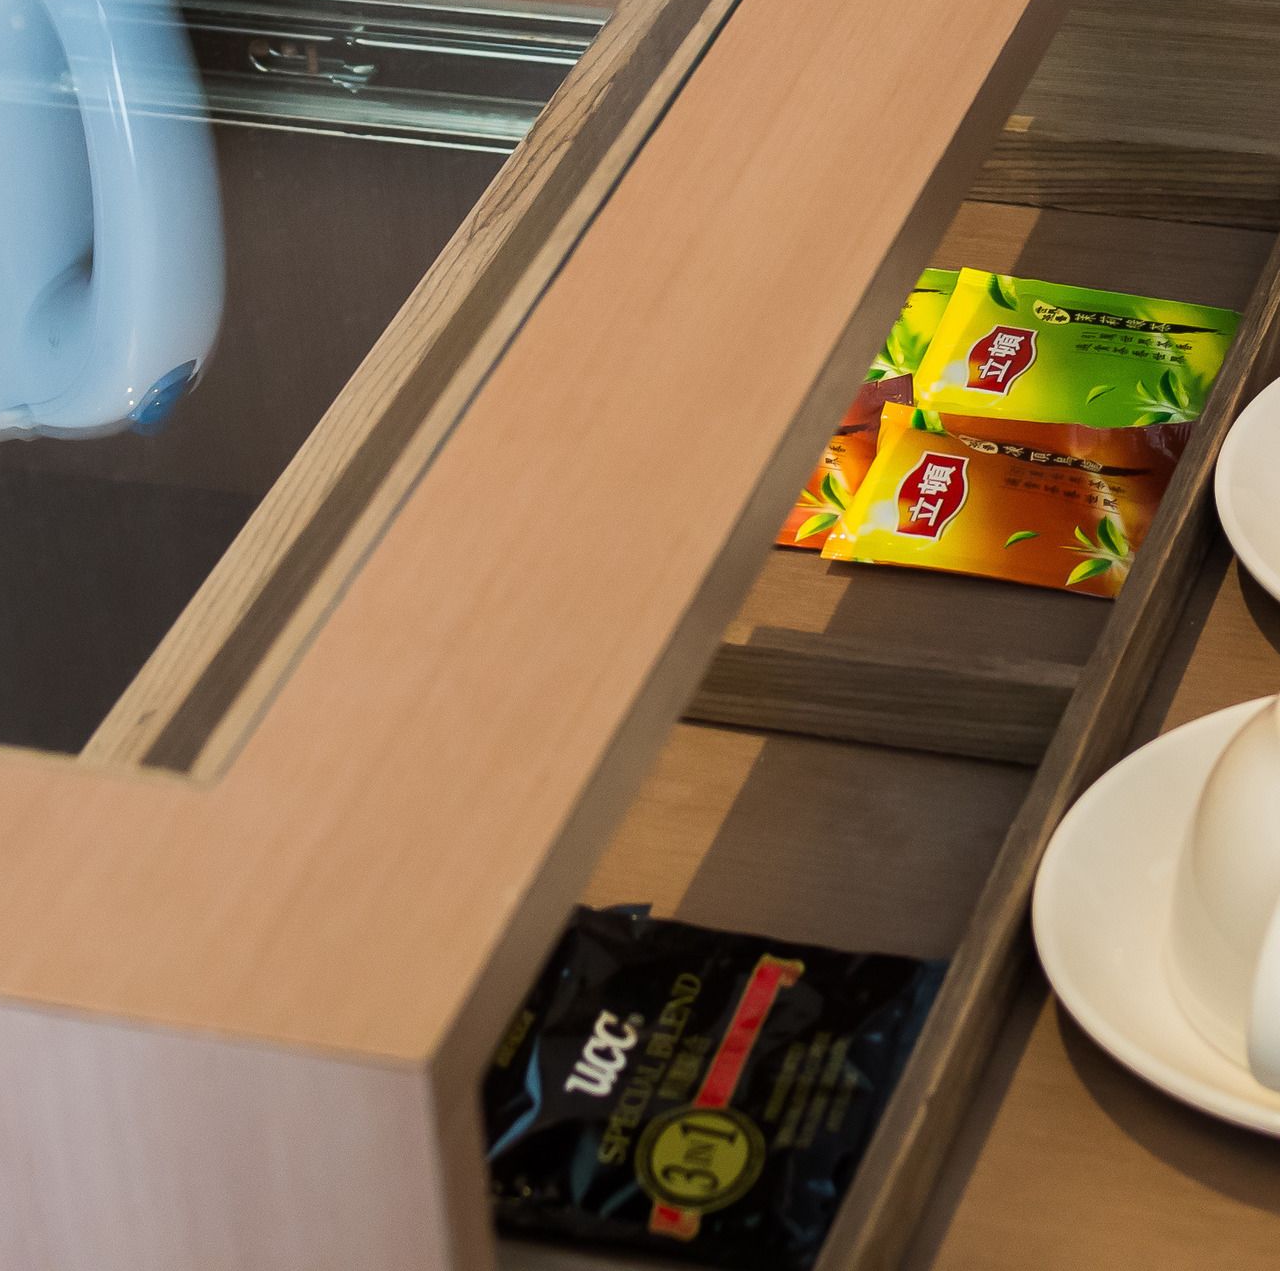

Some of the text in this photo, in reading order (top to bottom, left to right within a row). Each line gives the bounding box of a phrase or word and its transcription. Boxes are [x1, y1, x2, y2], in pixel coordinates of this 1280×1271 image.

[977, 332, 1025, 383] 立頓
[908, 462, 957, 526] 立頓
[564, 1009, 638, 1097] UCC
[661, 1164, 720, 1192] 3
